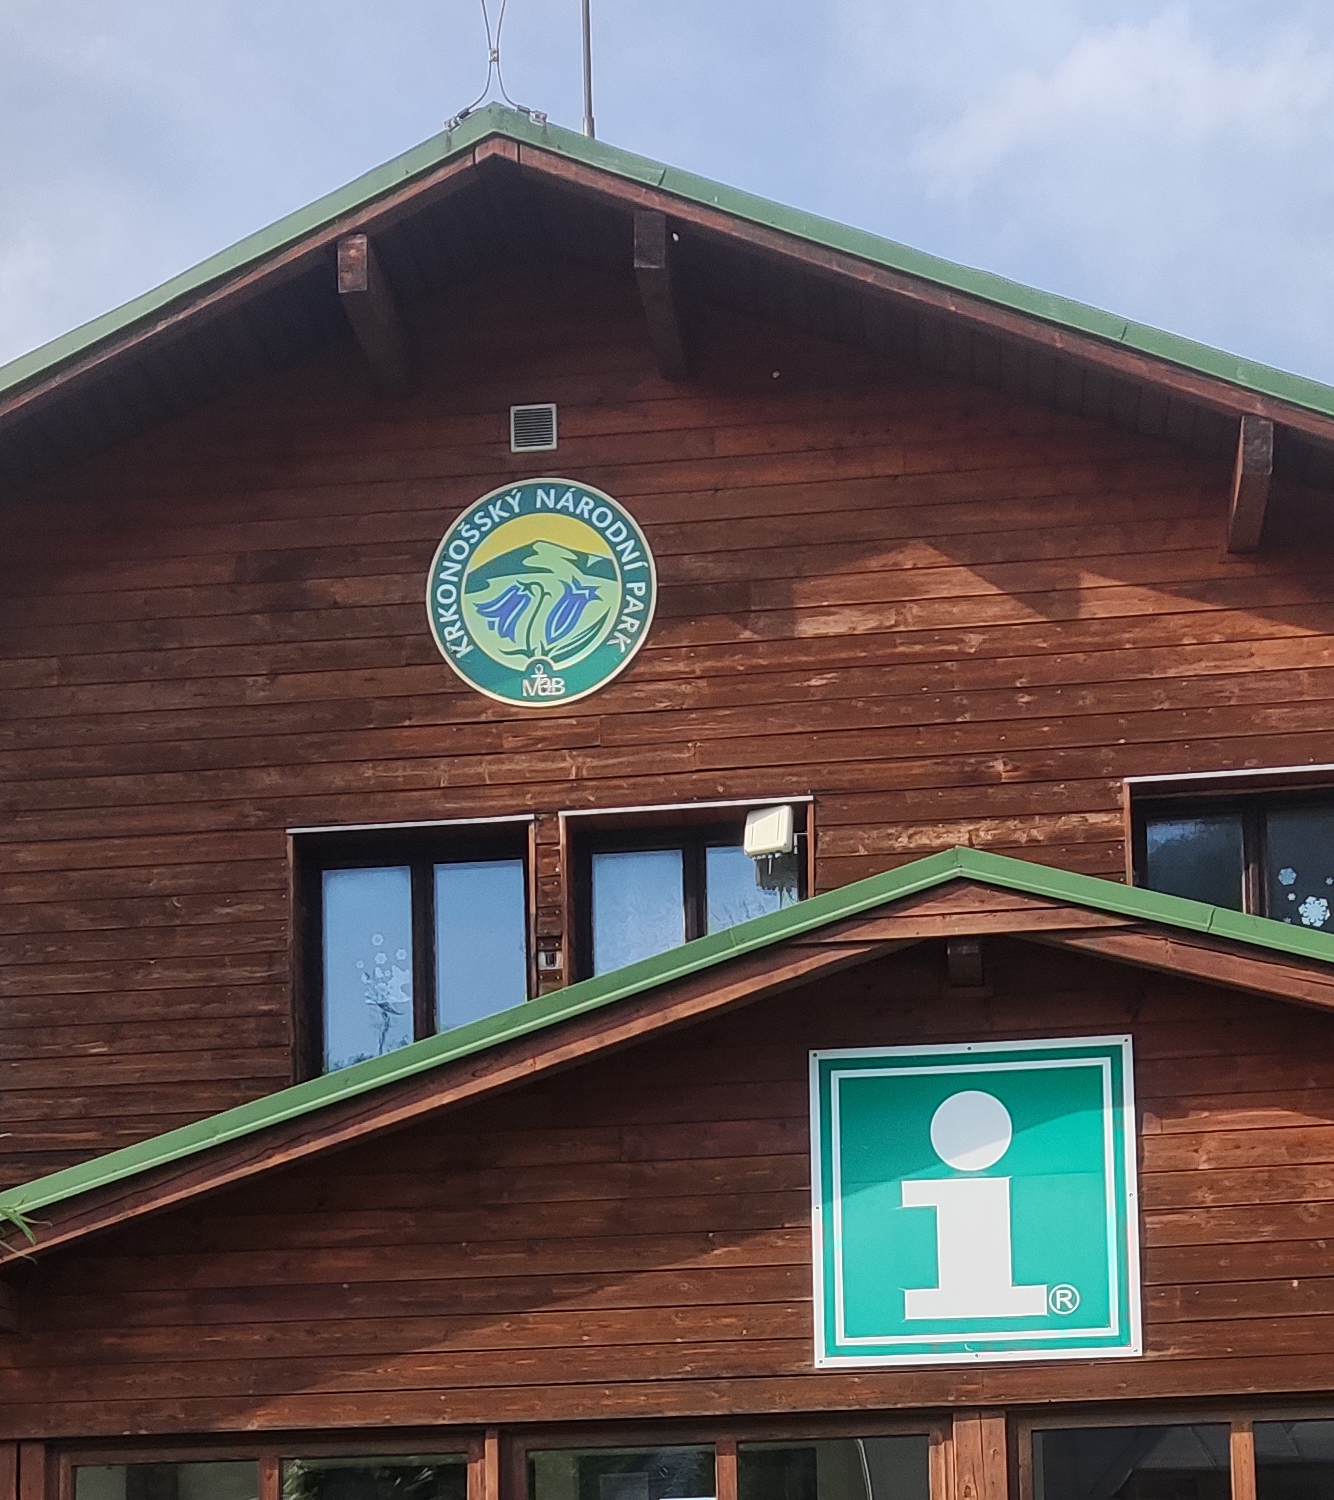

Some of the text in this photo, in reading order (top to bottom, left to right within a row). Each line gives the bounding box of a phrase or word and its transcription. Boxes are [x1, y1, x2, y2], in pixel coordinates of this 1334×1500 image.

[436, 487, 649, 659] KRKONOŠSKÝ NÁRODNÍ PARK
